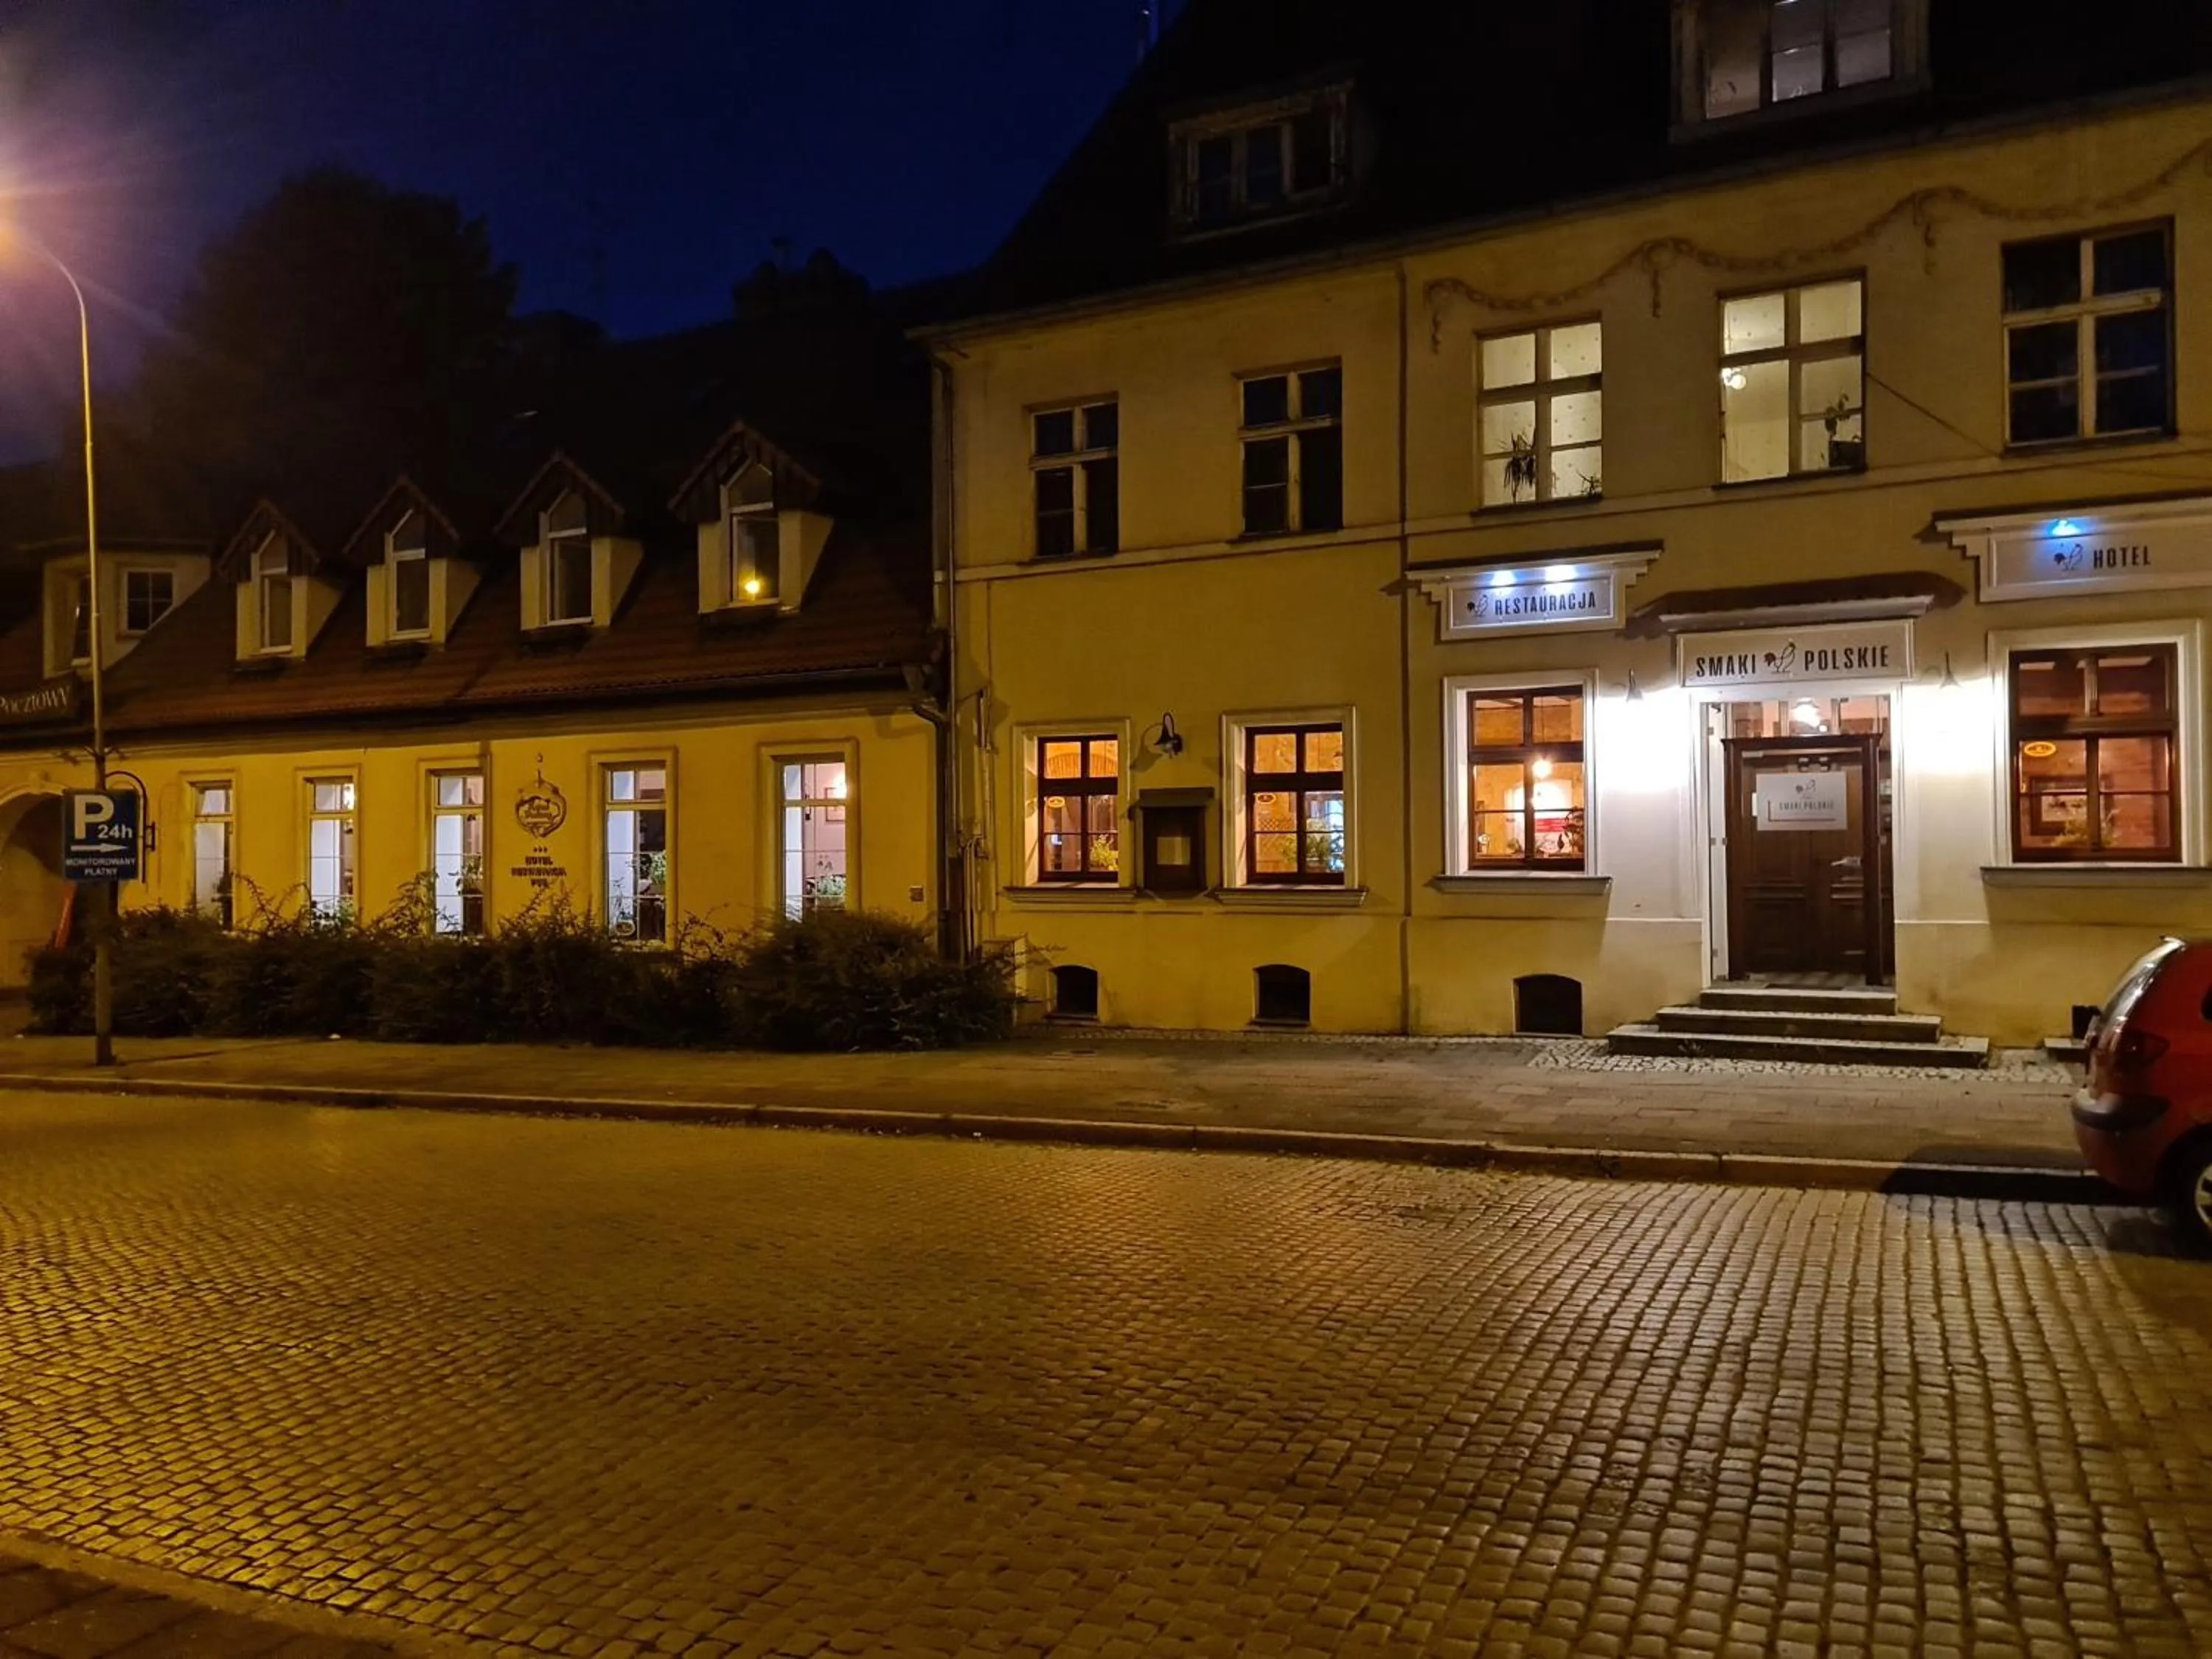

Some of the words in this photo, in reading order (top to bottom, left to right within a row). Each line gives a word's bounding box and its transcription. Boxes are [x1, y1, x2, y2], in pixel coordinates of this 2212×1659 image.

[2093, 546, 2151, 568] HOTEL
[1495, 591, 1596, 616] RESTAURACJA
[1696, 654, 1756, 678] SMAKI
[1804, 645, 1889, 672] POLSKIE
[74, 794, 114, 839] P
[97, 824, 133, 838] 24h
[66, 857, 136, 866] MONITOROWANY
